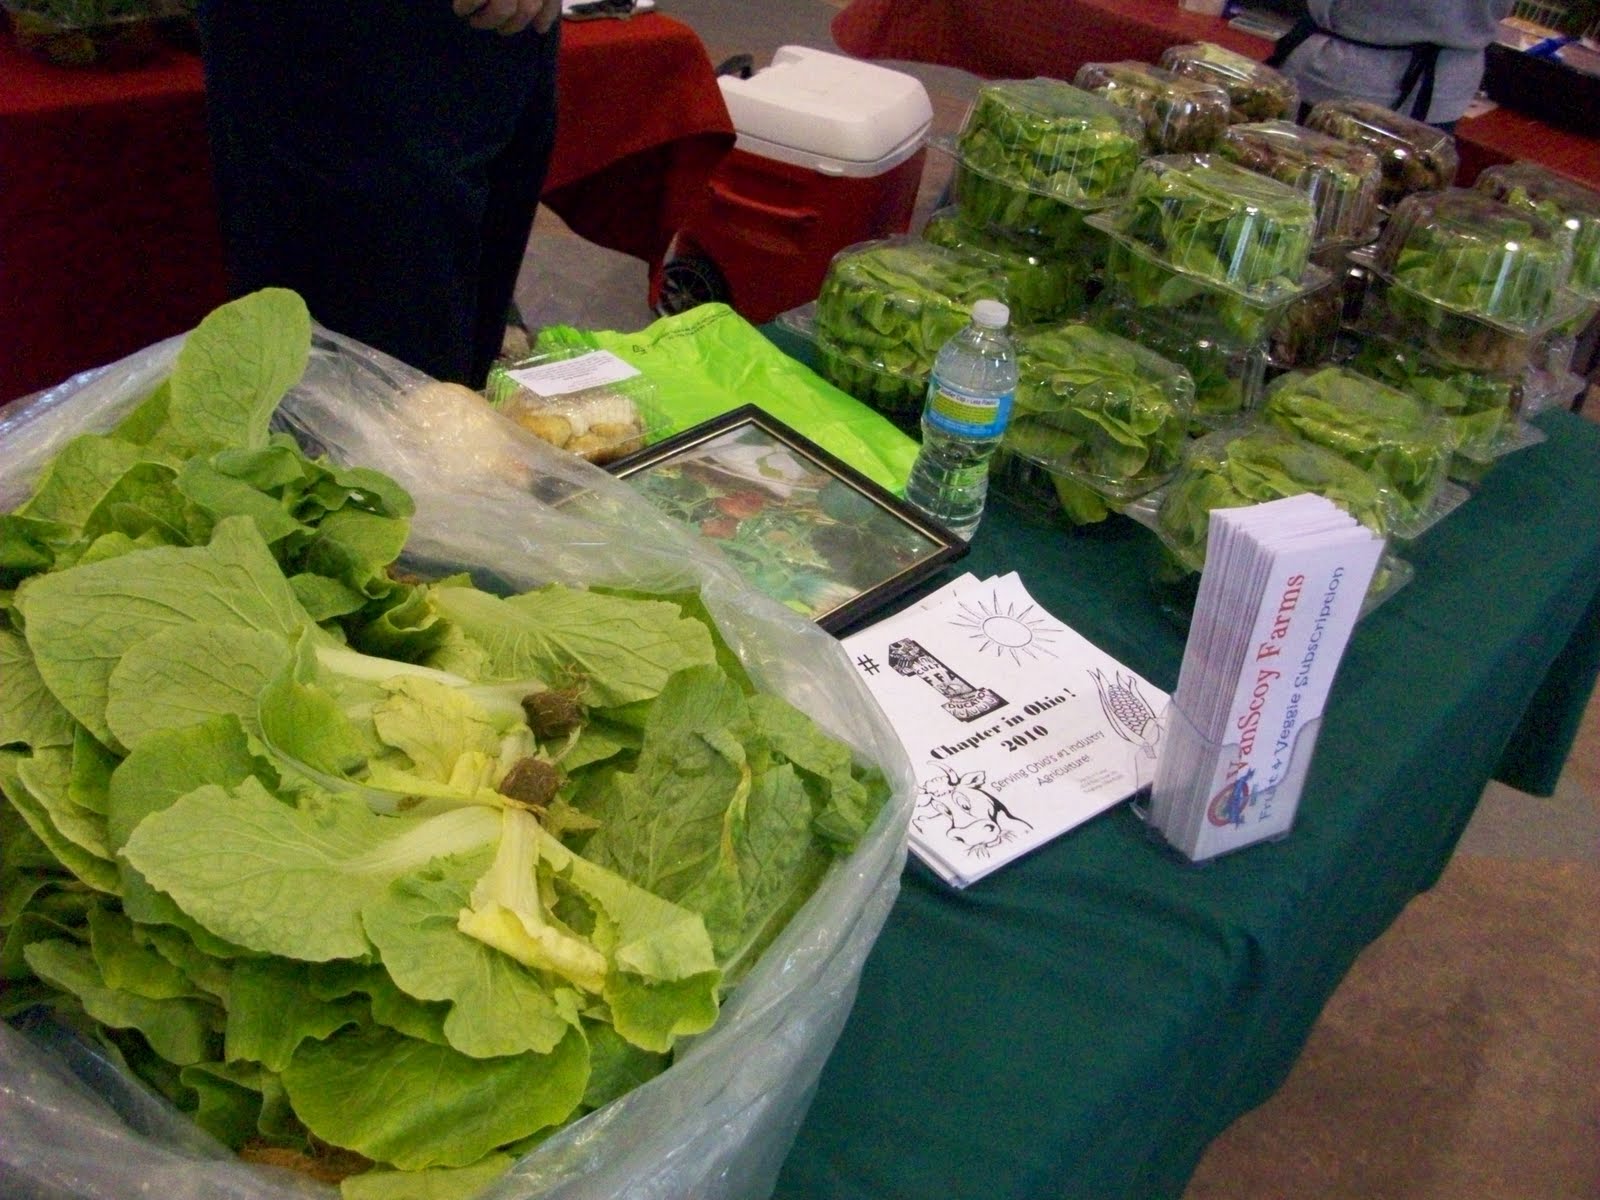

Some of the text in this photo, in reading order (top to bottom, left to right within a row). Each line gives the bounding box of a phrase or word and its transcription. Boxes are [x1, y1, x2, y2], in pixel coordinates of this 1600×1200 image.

[1226, 667, 1281, 780] VanScoy
[1256, 574, 1305, 664] Farms
[930, 725, 1001, 760] Chapter
[1002, 714, 1025, 728] in
[1024, 696, 1067, 716] Ohio
[1001, 725, 1049, 752] 2010
[1258, 773, 1280, 822] Fruit
[1274, 693, 1301, 754] Veggie
[991, 768, 1028, 792] Serving
[1029, 754, 1058, 774] Ohio's
[1058, 748, 1070, 758] #1
